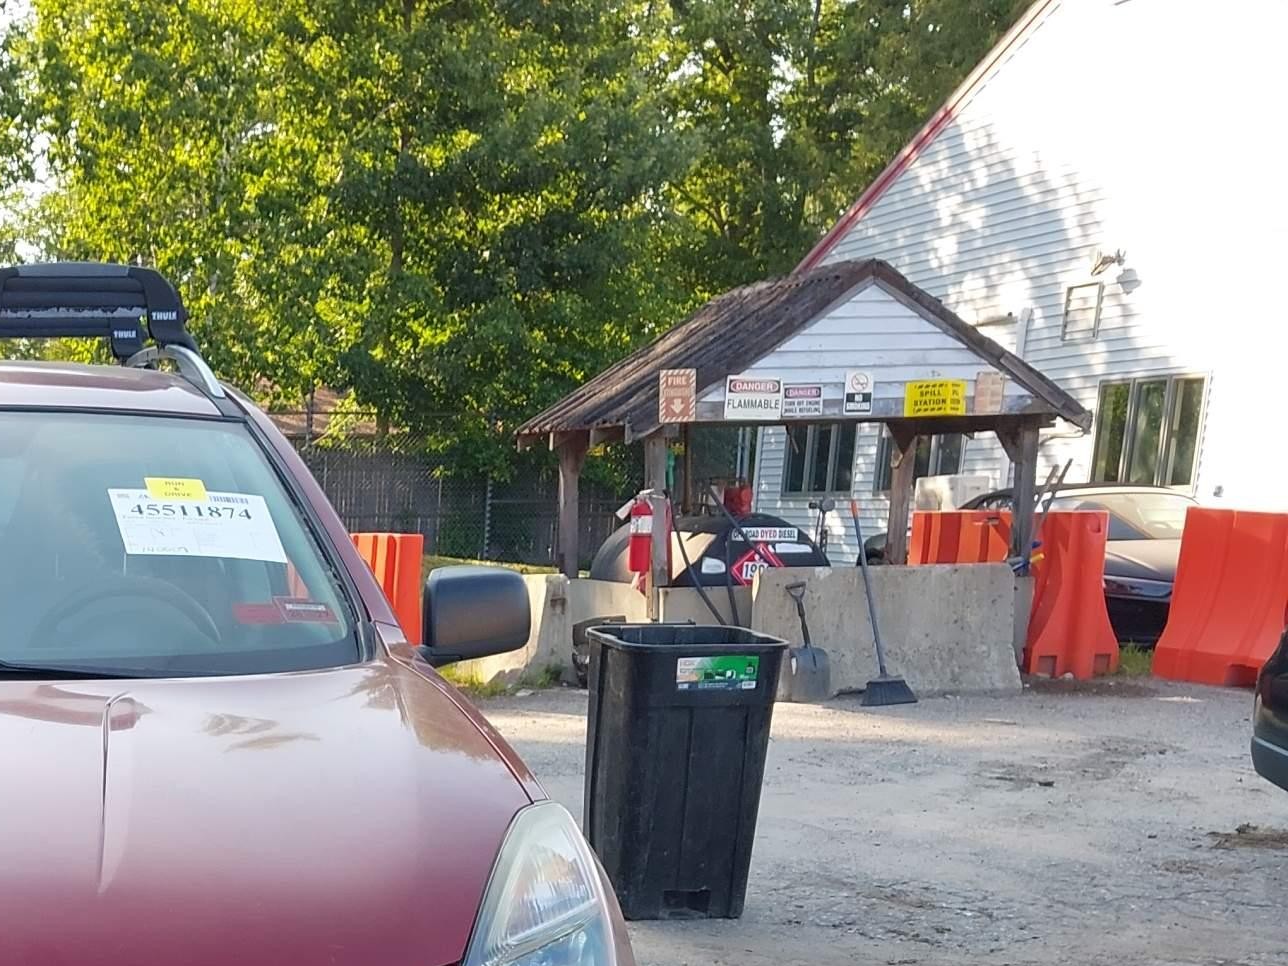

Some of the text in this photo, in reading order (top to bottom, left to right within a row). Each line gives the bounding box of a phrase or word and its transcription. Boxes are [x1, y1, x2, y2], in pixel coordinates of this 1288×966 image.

[152, 311, 177, 321] THULE
[114, 330, 137, 339] THULE
[667, 376, 687, 386] FIRE
[735, 382, 774, 392] DANGER
[788, 388, 818, 397] DANGER
[919, 388, 942, 397] SPILL
[726, 398, 780, 410] FLAMMABLE
[913, 398, 946, 407] STATION
[130, 503, 252, 520] 45511874
[760, 529, 777, 538] DYED
[778, 529, 796, 538] DIESEL
